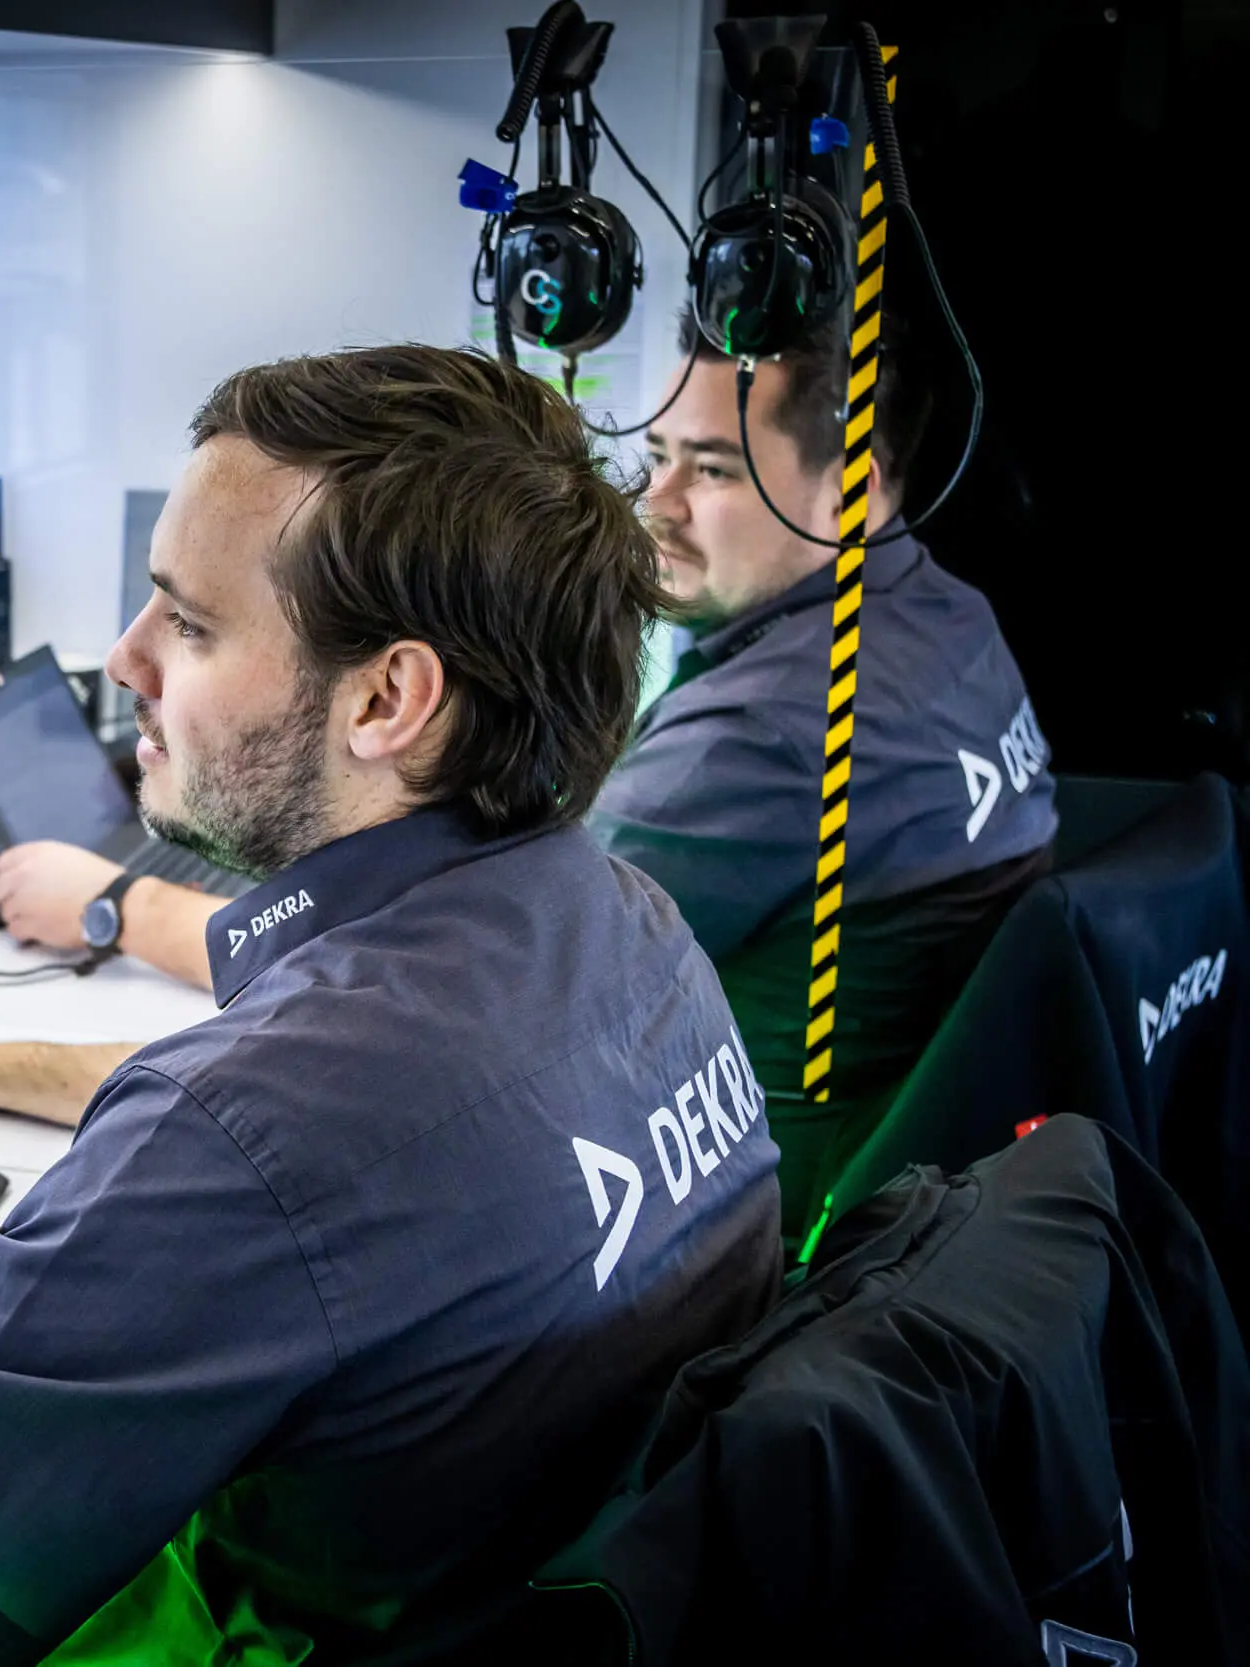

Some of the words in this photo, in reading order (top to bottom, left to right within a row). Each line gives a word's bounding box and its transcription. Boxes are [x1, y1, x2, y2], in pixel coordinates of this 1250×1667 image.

[1000, 696, 1046, 793] DEK
[250, 889, 315, 936] DEKRA
[1157, 948, 1227, 1041] DEKRA
[648, 1025, 764, 1205] DEKRA
